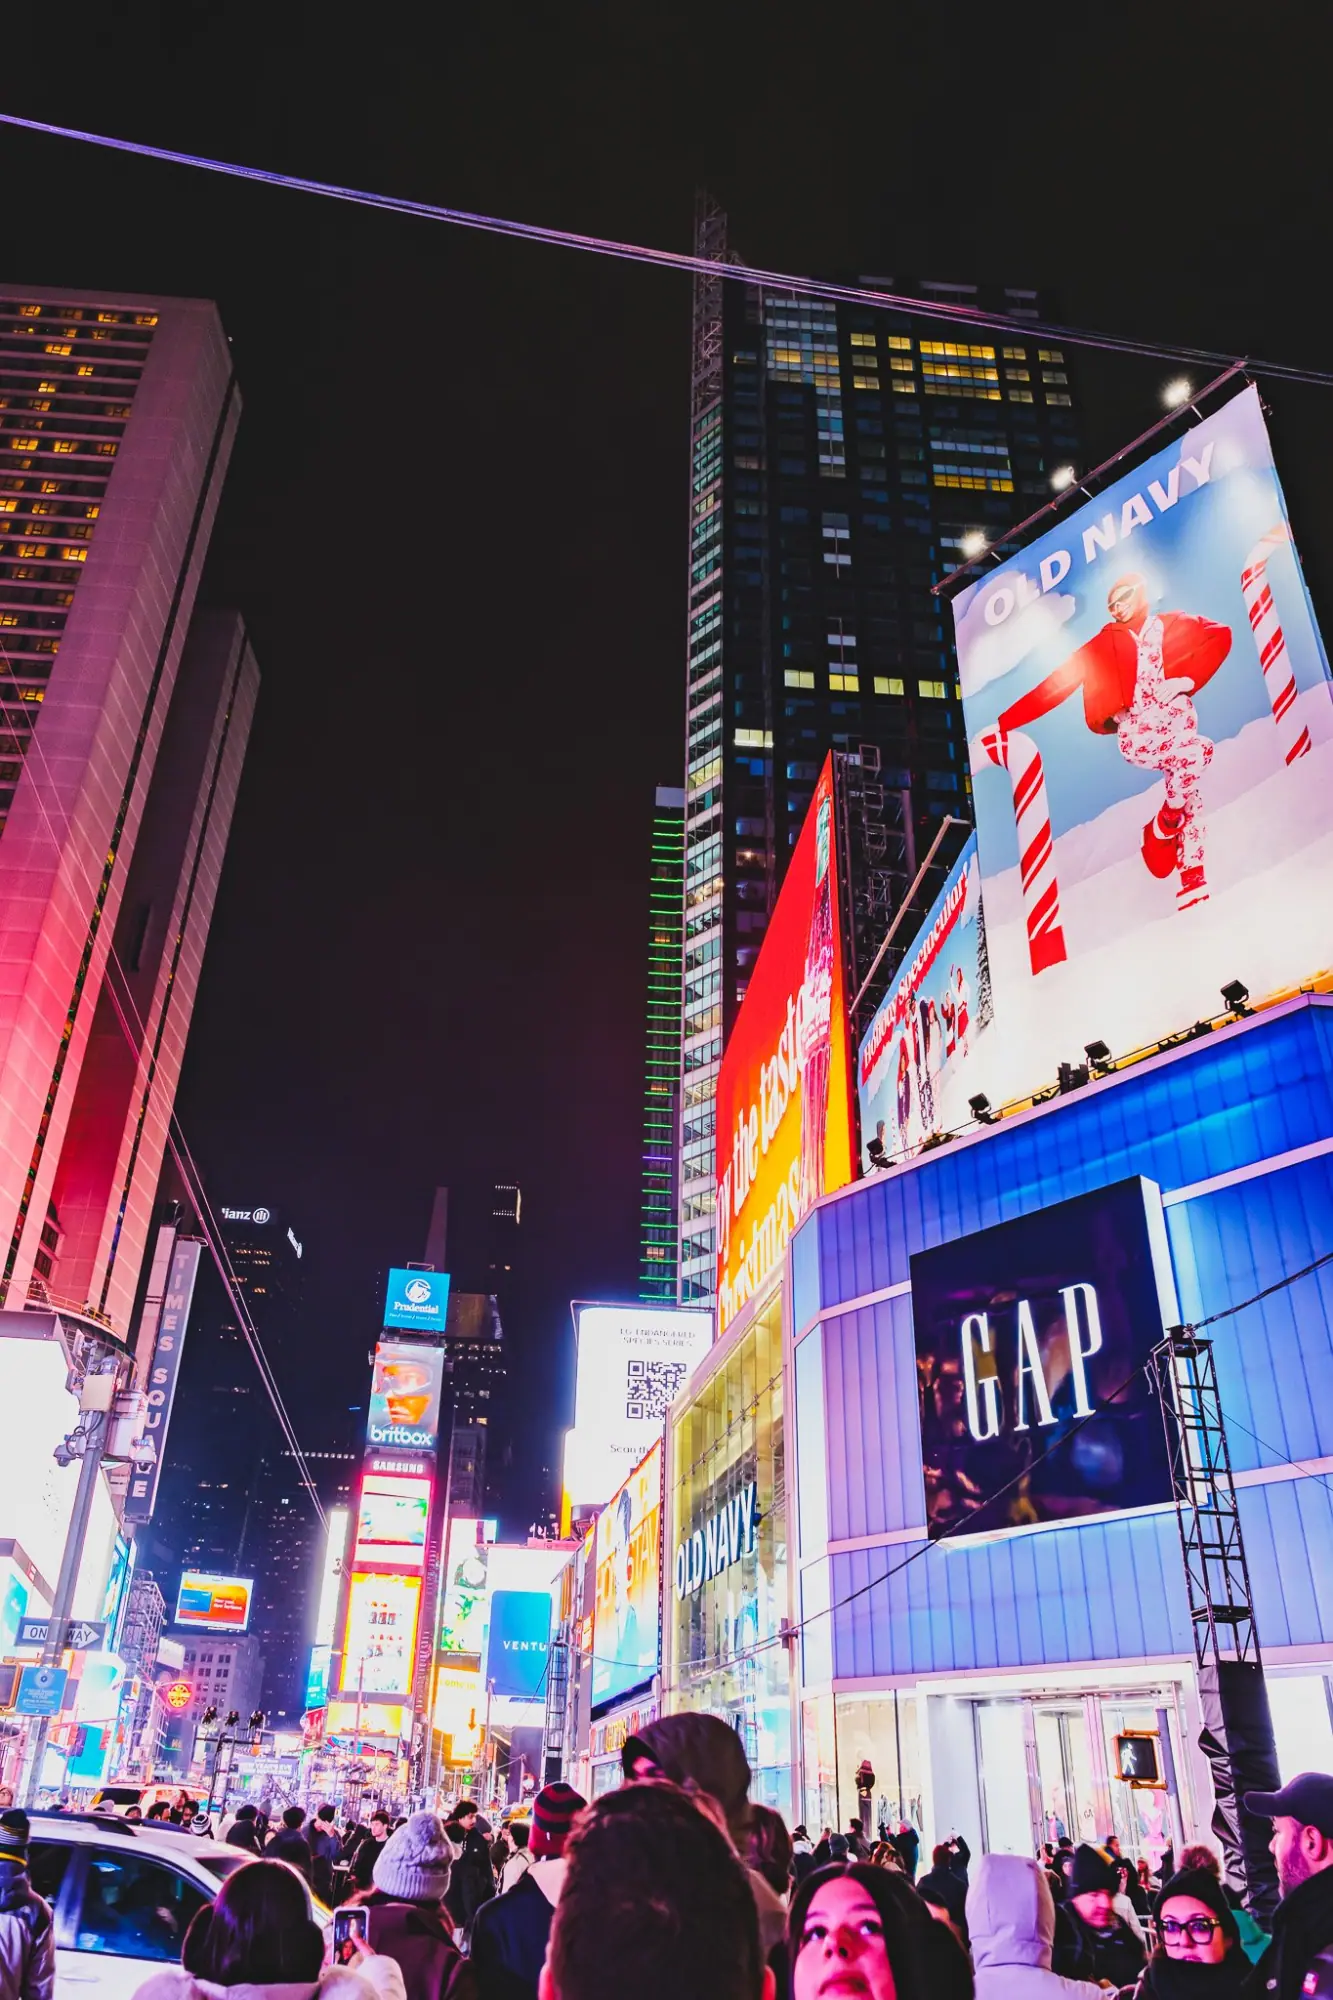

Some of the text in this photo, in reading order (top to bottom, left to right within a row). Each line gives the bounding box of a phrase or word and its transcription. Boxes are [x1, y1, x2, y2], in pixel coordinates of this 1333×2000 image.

[984, 441, 1215, 626] OLD NAVY
[863, 861, 968, 1070] Holiday Spectacular!
[733, 1108, 758, 1216] the
[393, 1301, 439, 1314] Prudential
[131, 1253, 190, 1498] TIMES SQUAE
[961, 1282, 1103, 1442] GAP
[370, 1424, 434, 1446] britbox
[372, 1460, 425, 1474] SAMSUNG
[610, 1444, 636, 1453] Scan
[676, 1529, 706, 1602] OLD
[704, 1481, 757, 1582] NAVY
[29, 1626, 92, 1642] ON WAY
